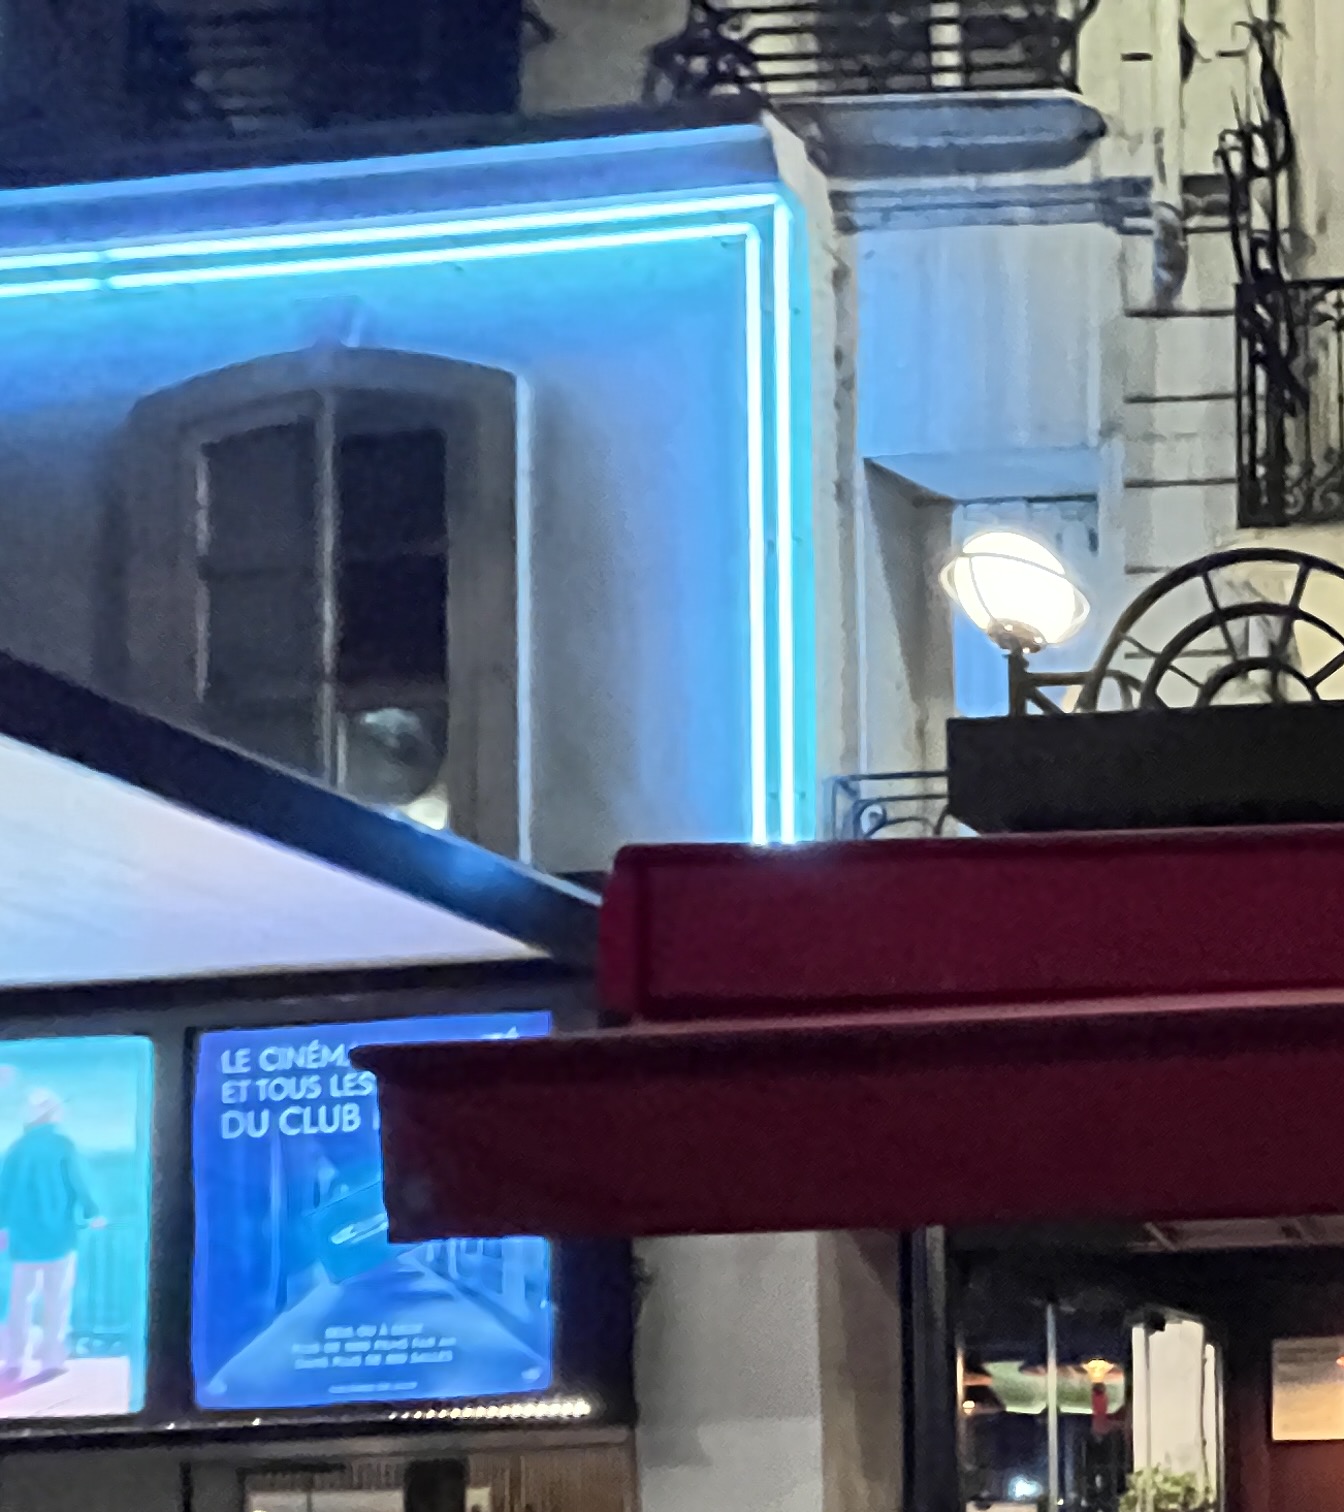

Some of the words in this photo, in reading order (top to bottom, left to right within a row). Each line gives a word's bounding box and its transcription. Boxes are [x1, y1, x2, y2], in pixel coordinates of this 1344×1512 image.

[221, 1047, 252, 1074] LE
[259, 1039, 350, 1072] CINÉM
[221, 1079, 252, 1104] ET
[256, 1074, 322, 1101] TOUS
[329, 1070, 377, 1097] LES
[221, 1108, 269, 1140] DU
[279, 1103, 361, 1136] CLUB
